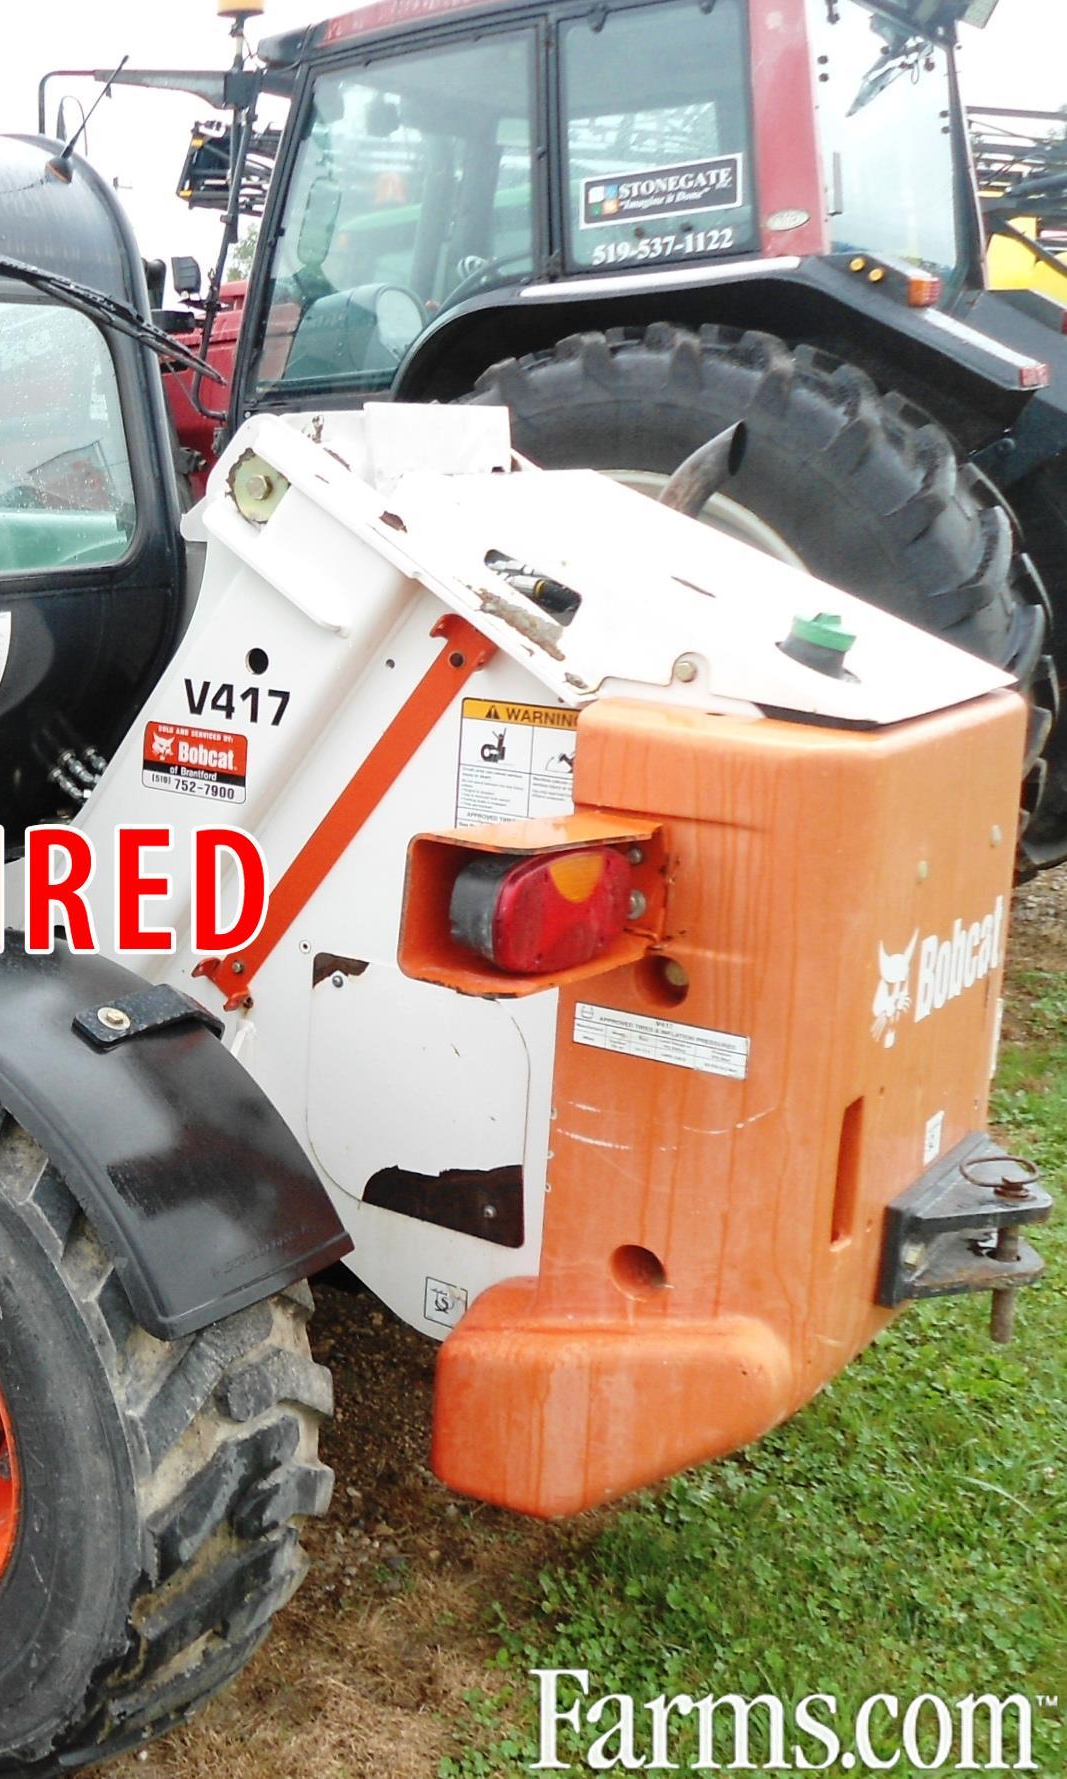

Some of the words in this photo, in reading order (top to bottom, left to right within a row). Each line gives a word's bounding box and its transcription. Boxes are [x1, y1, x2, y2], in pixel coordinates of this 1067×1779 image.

[618, 167, 732, 200] STONEGATE
[592, 227, 734, 266] 519-537-1122
[184, 678, 291, 726] V417
[176, 727, 189, 737] AND
[191, 730, 222, 742] SERVICED
[178, 741, 236, 770] Bobcat
[169, 765, 179, 775] of
[180, 767, 217, 781] Brantford
[174, 779, 235, 800] 752-7900
[914, 895, 1005, 1024] Bobcat
